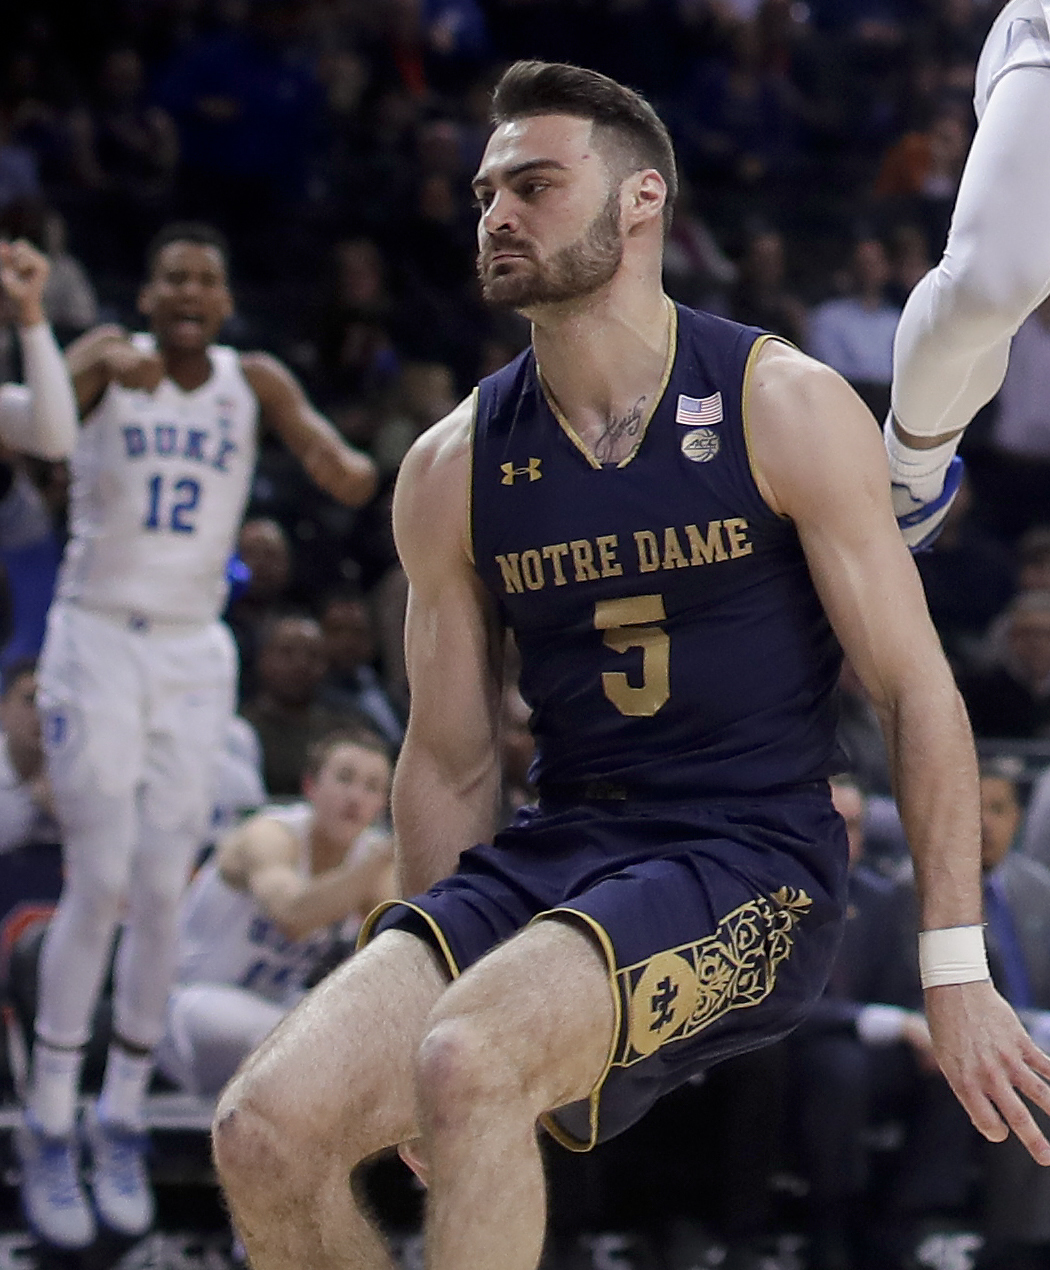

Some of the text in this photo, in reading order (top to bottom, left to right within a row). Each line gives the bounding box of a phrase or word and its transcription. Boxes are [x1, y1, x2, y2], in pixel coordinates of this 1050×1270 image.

[143, 473, 203, 534] 12
[495, 516, 754, 595] NOTRE DAME
[593, 593, 671, 718] 5
